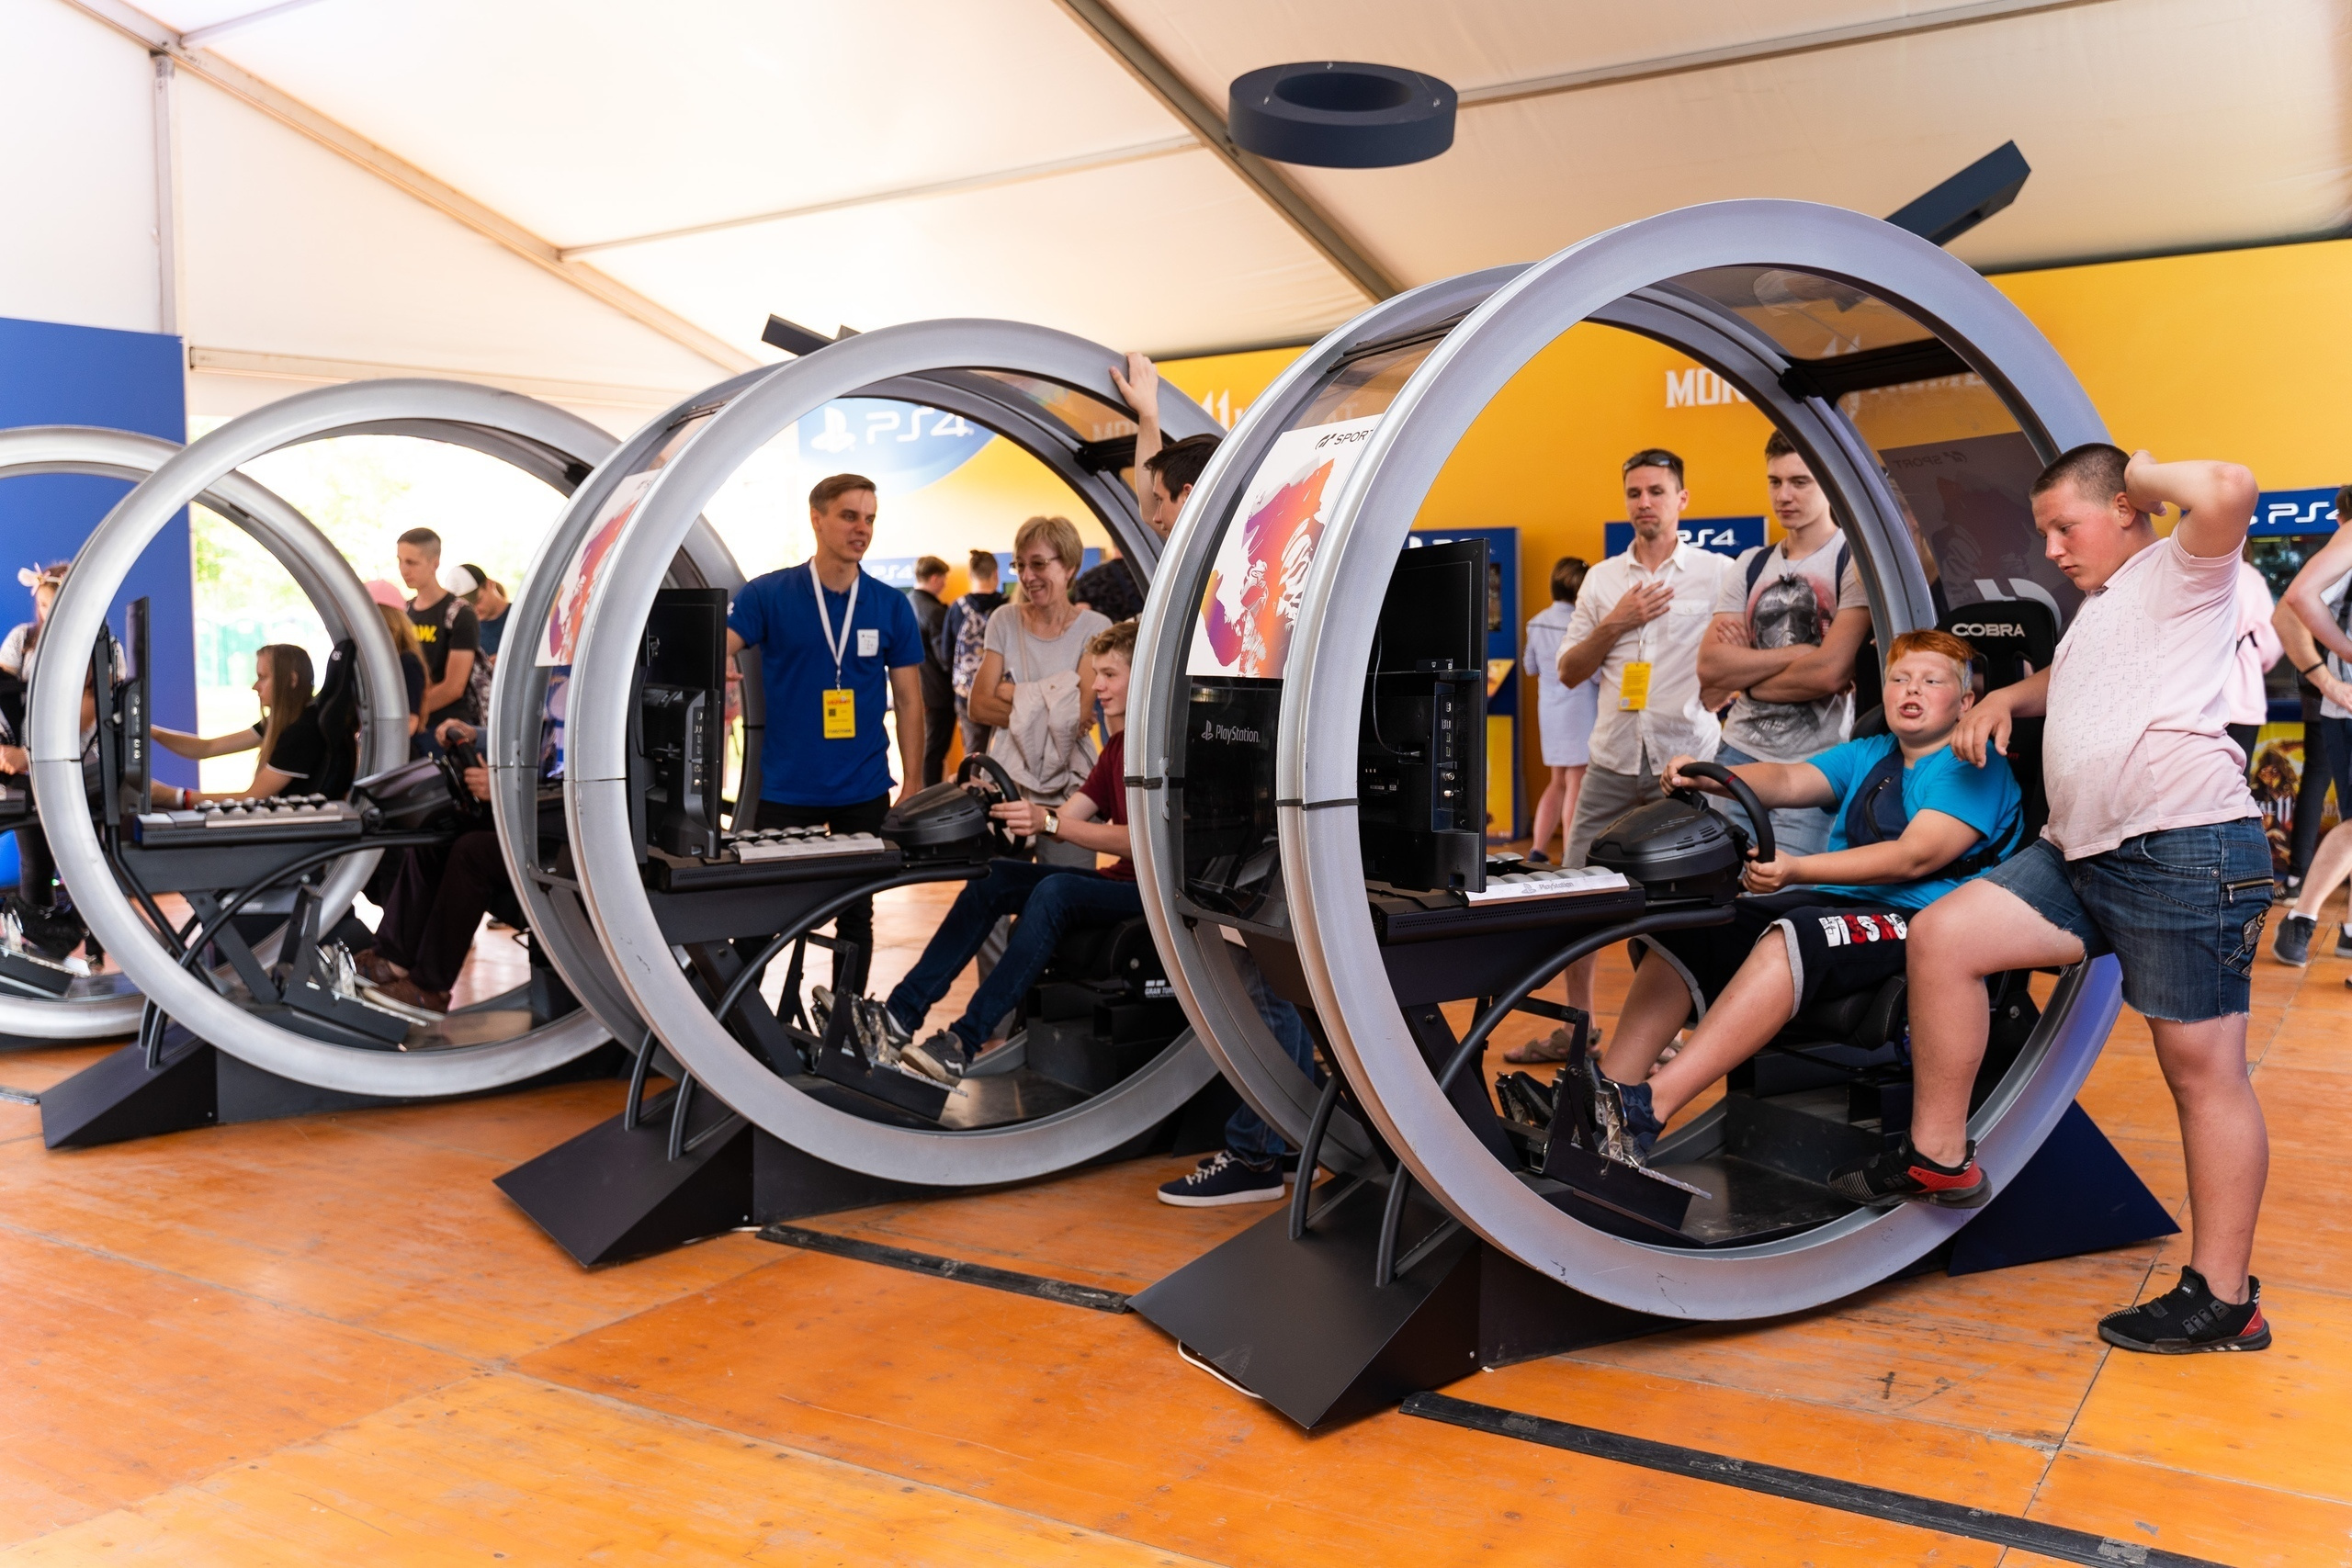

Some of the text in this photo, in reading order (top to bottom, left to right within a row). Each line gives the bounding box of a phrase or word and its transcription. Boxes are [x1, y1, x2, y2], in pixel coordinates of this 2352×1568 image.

[865, 406, 970, 445] PS4
[1334, 429, 1374, 446] SPOR
[1677, 528, 1736, 547] PS4
[870, 564, 914, 581] PS4
[1951, 623, 2025, 637] COBRA
[1215, 724, 1260, 746] PlayStation
[1538, 881, 1575, 892] PlayStation
